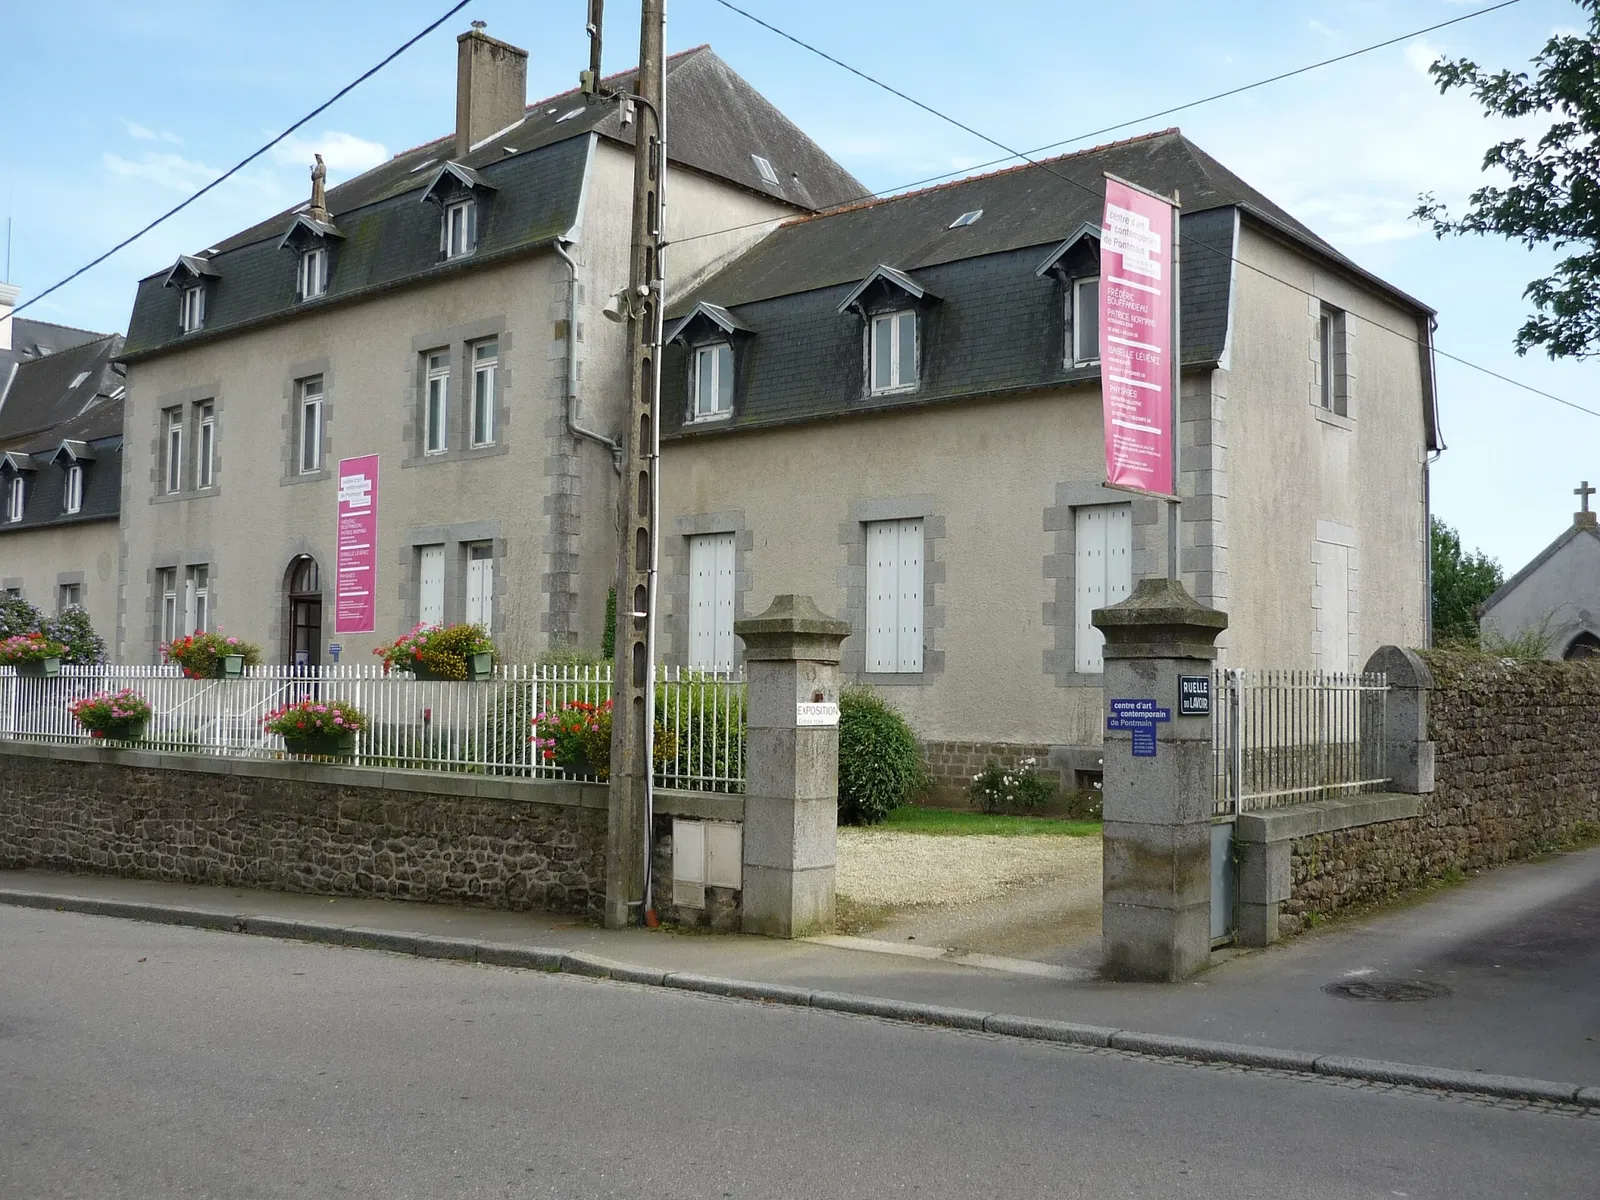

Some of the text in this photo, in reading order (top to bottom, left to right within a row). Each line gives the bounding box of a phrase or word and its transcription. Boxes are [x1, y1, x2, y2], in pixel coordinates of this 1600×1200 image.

[1109, 211, 1130, 225] centre
[1103, 235, 1145, 256] de Pontmain
[1107, 287, 1135, 302] FRÉDÉRIC
[1107, 308, 1130, 322] PATRICE
[1131, 316, 1156, 328] NORMAND
[1107, 345, 1134, 360] ISABELLE
[1183, 682, 1208, 693] RUELLE
[1136, 701, 1152, 709] d'art
[1189, 697, 1208, 709] LAVOIR
[797, 706, 839, 716] EXPOSITION
[1120, 710, 1166, 719] contemporain
[1110, 719, 1152, 727] de Pontmain
